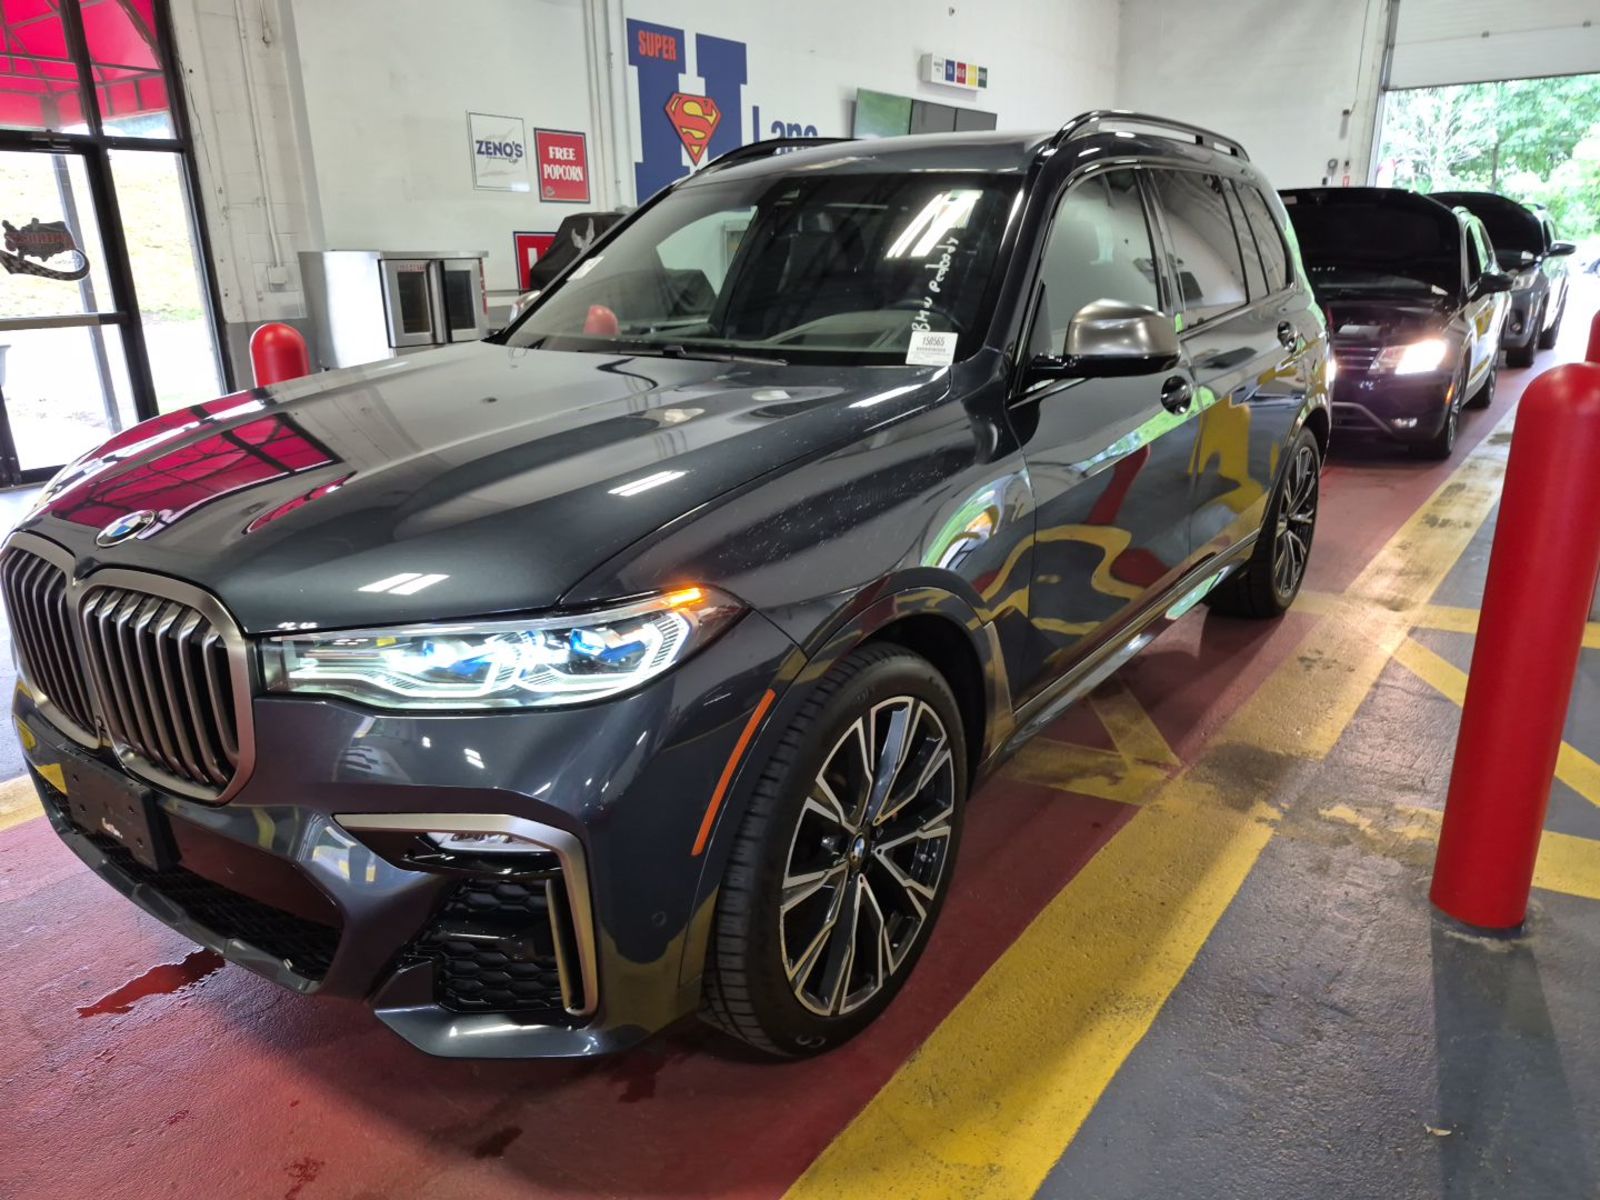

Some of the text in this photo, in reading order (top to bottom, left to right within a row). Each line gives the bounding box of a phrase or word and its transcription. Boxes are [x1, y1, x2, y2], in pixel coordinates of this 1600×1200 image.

[638, 30, 677, 61] SUPER
[475, 140, 524, 159] ZENO'S
[548, 145, 577, 161] FREE
[543, 163, 584, 182] POPCORN
